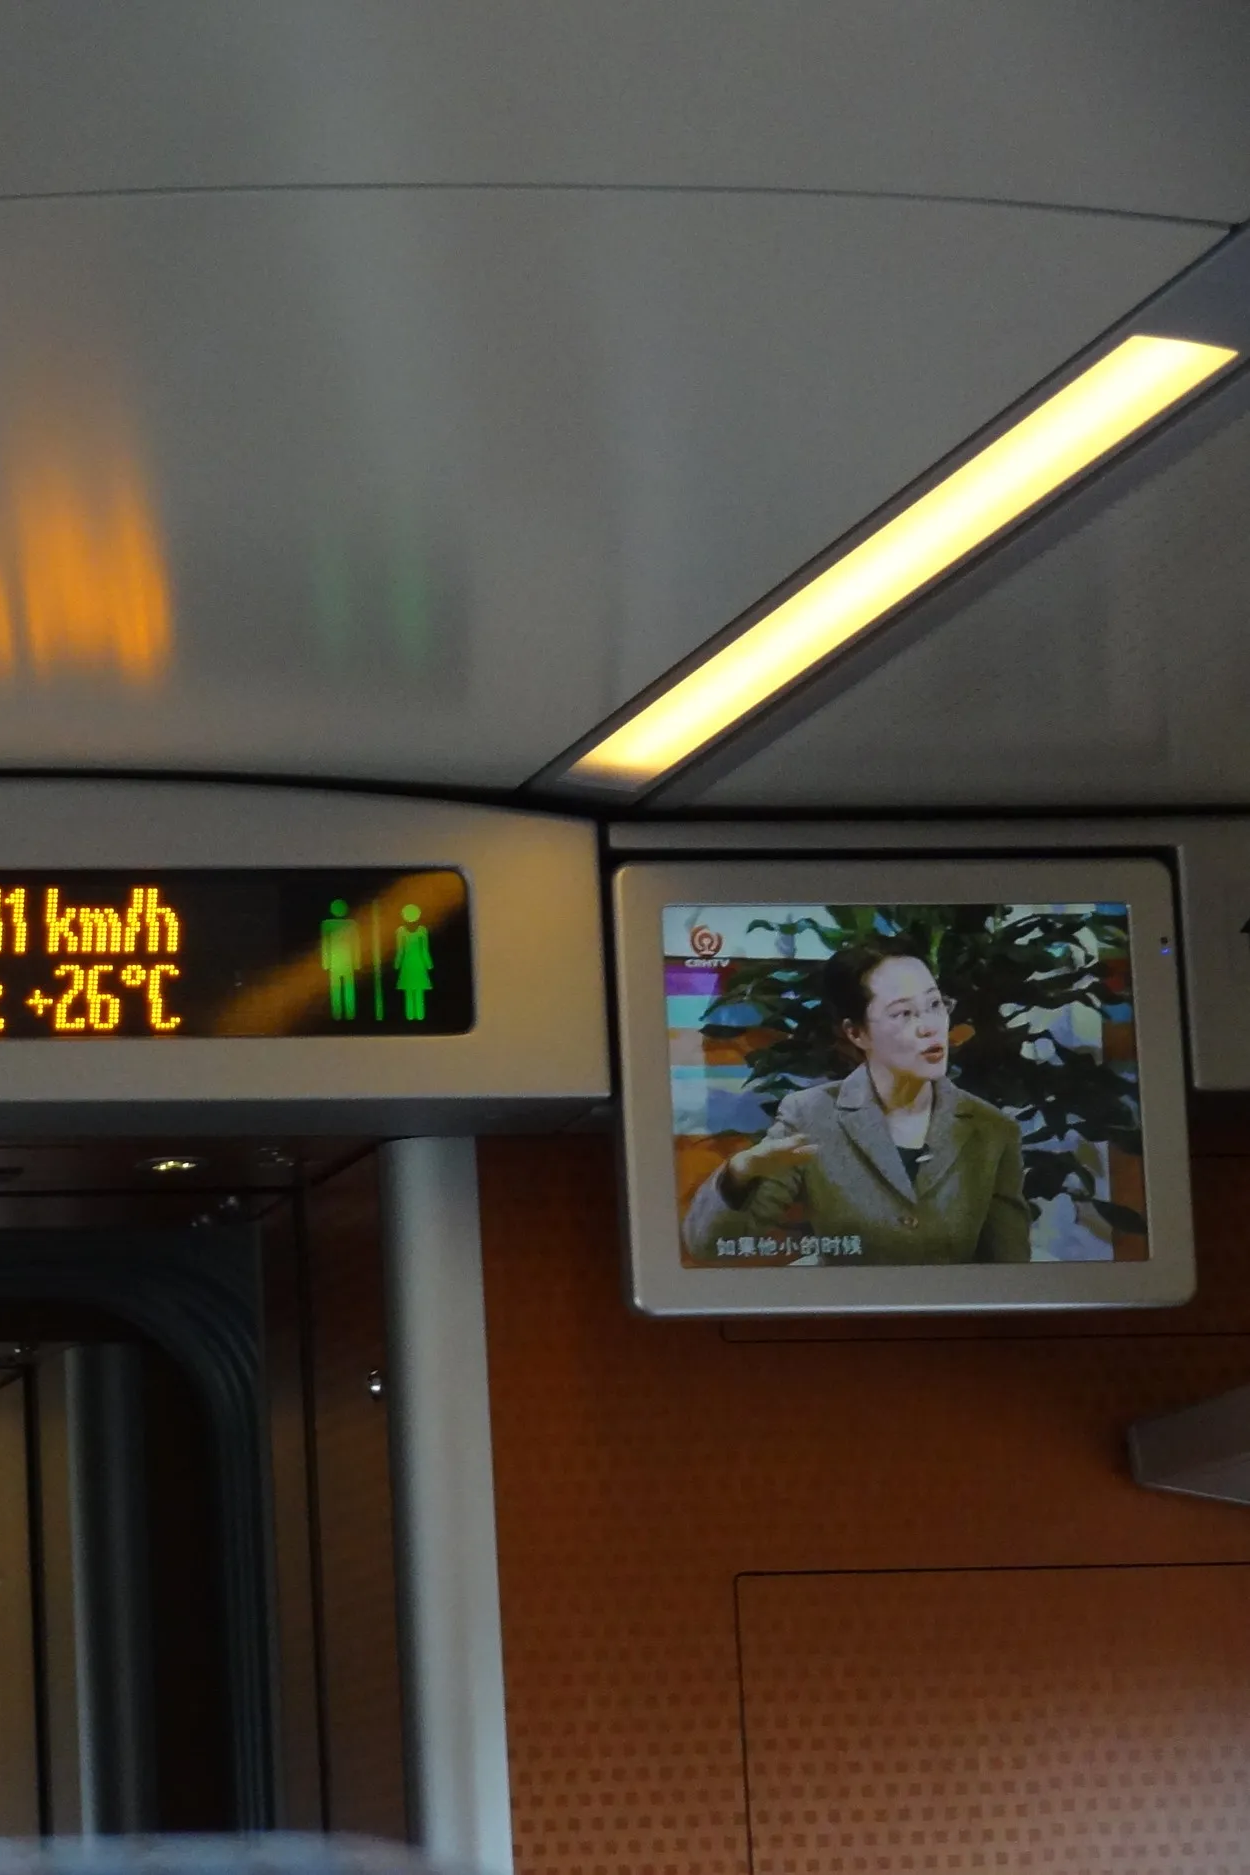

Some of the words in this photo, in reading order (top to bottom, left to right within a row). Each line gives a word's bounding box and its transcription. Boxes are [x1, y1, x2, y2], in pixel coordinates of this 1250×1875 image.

[45, 887, 179, 953] km/h
[716, 1235, 863, 1257] 如果他小的时候
